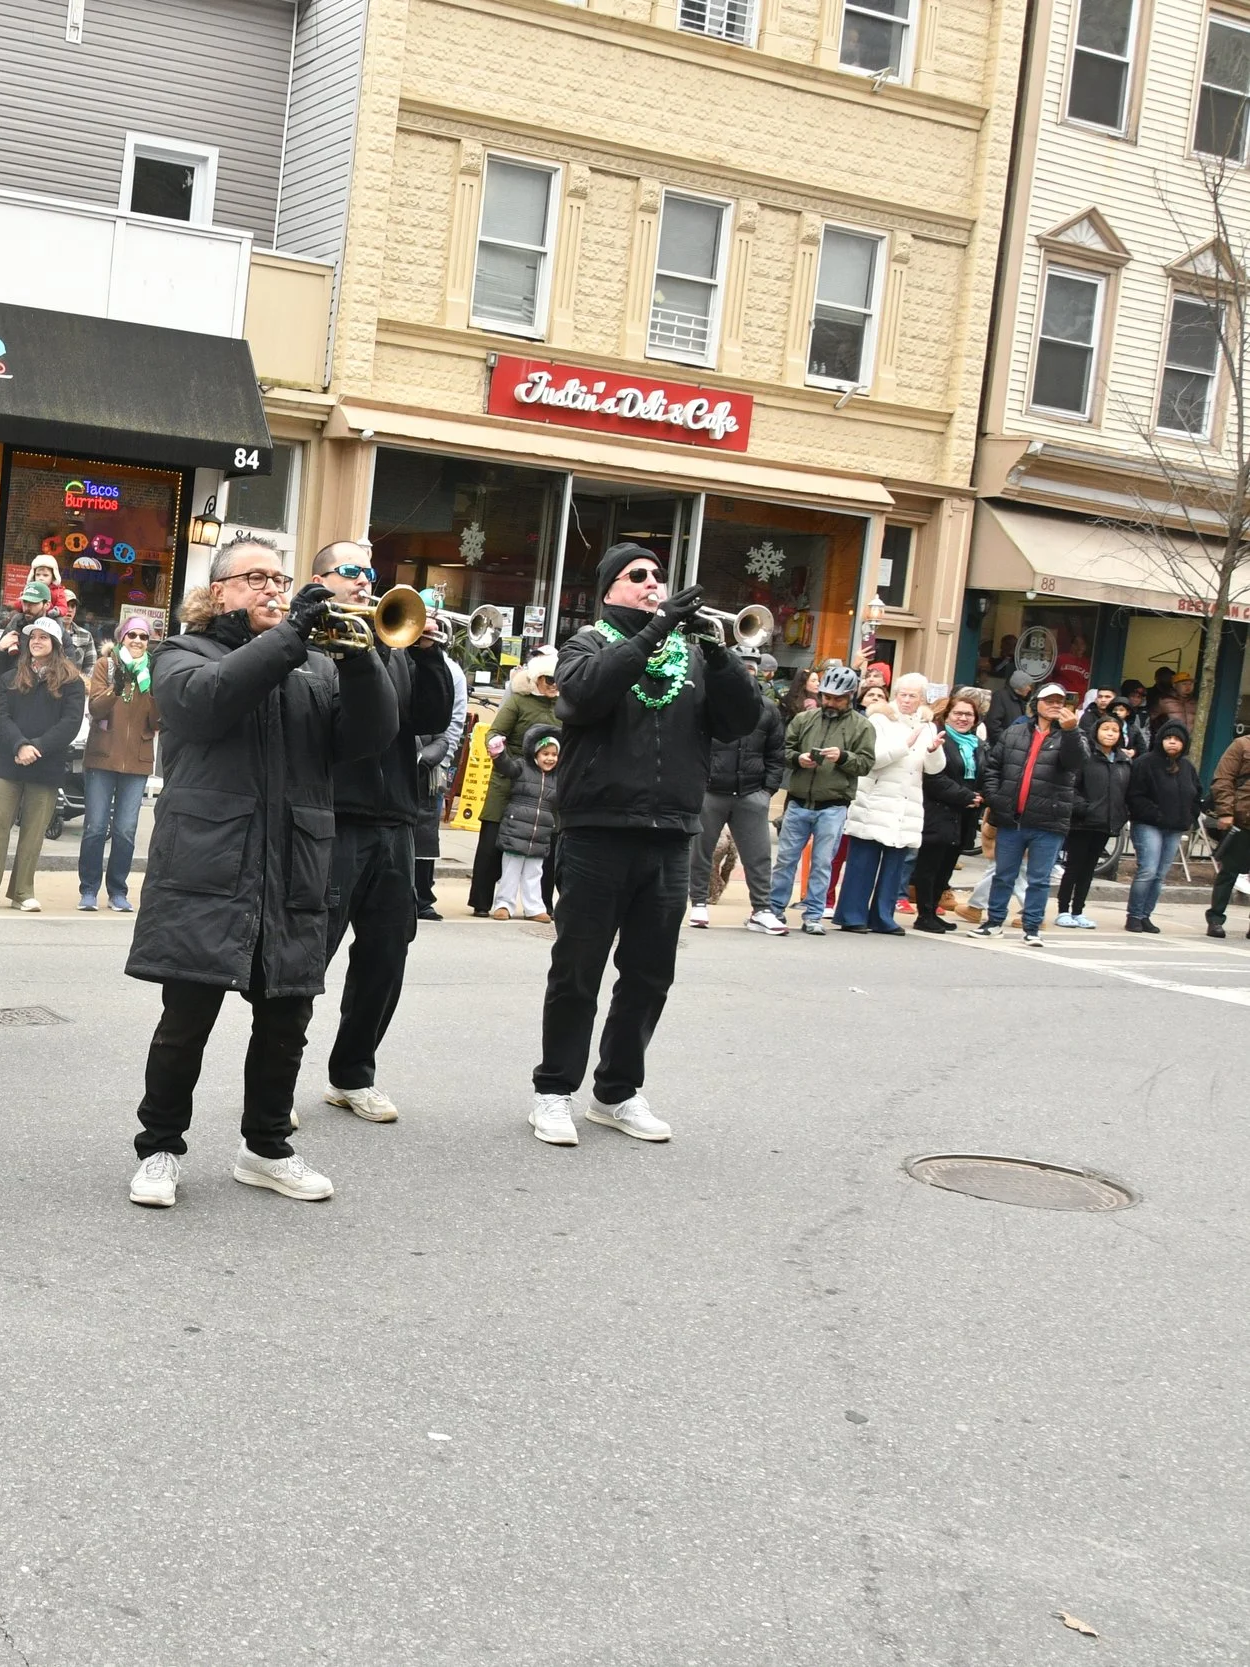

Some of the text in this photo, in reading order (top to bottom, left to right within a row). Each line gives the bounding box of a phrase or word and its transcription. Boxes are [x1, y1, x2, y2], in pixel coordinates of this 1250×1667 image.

[513, 371, 740, 441] Justin's Deli & Cafe
[234, 447, 260, 470] 84
[83, 480, 119, 497] Tacos
[65, 492, 118, 511] Burritos
[41, 532, 136, 564] COCO
[1041, 577, 1056, 592] 88
[1030, 636, 1046, 649] 88
